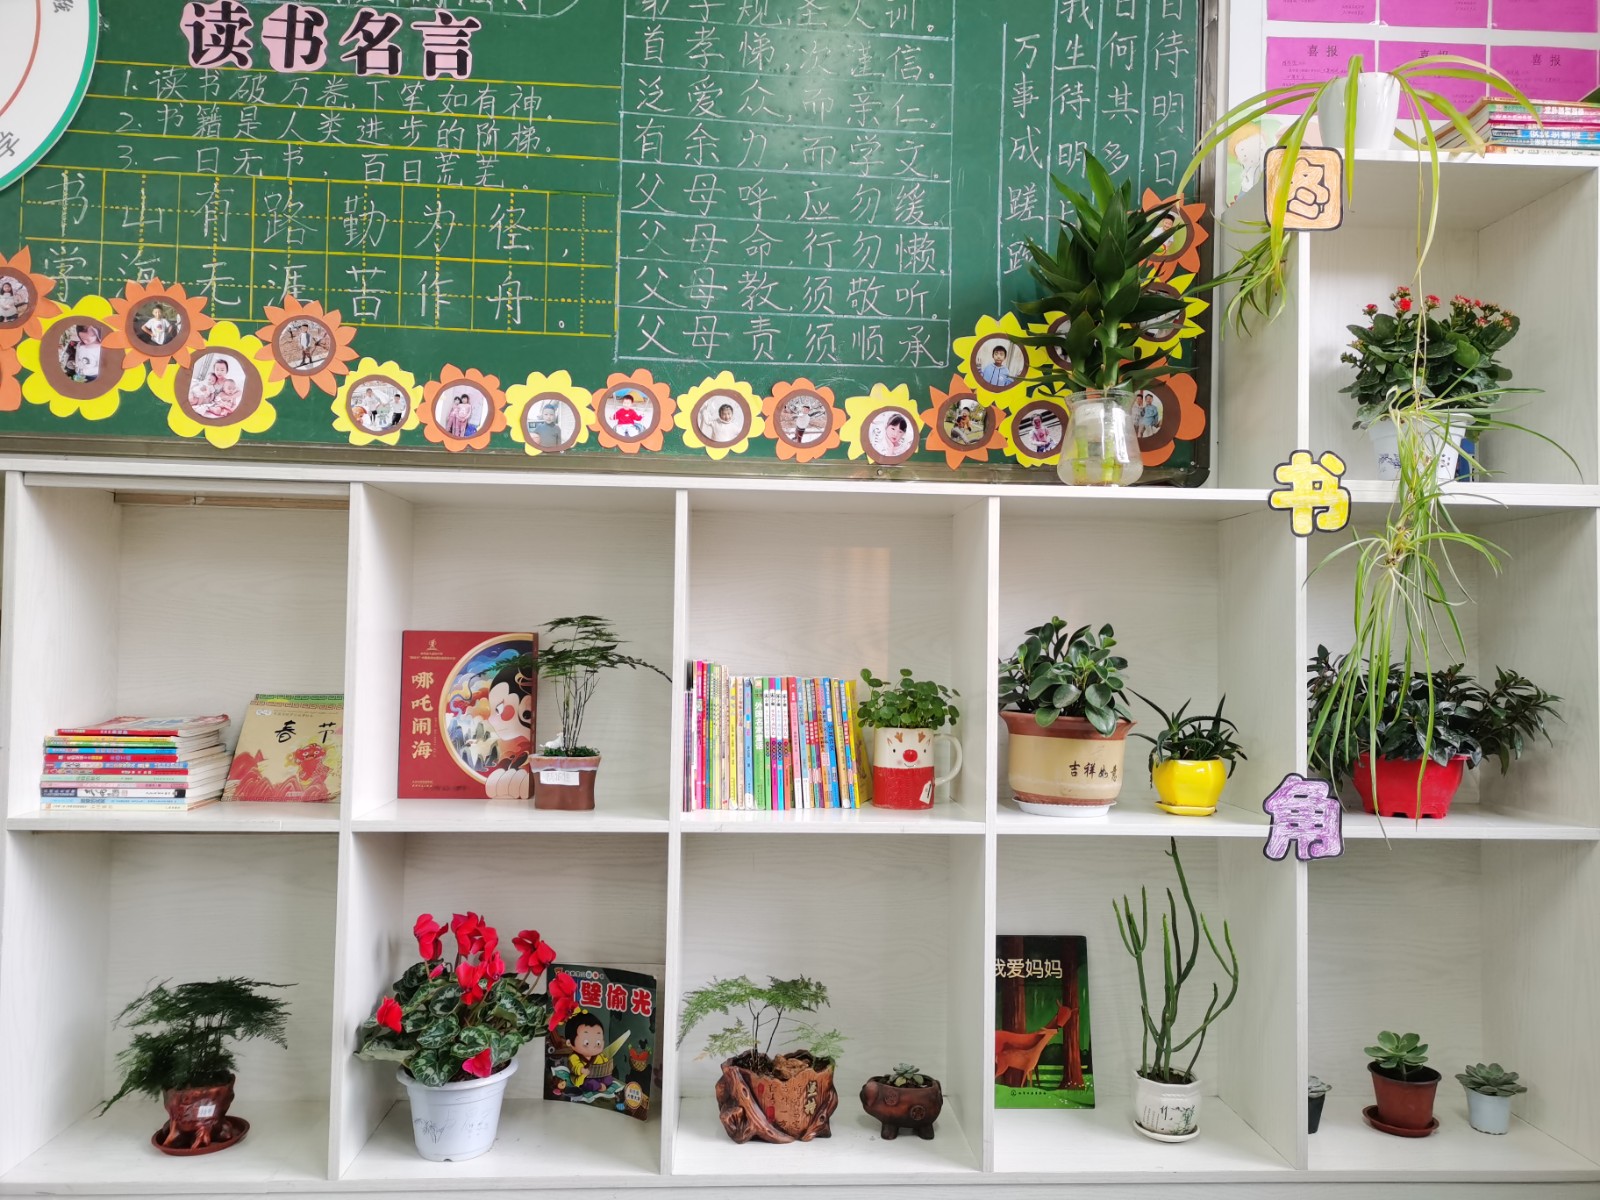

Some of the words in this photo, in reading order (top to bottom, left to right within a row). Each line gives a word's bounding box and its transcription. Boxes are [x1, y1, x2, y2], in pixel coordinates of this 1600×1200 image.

[186, 2, 481, 79] 读书名言
[1268, 449, 1351, 537] 书
[275, 720, 337, 744] 春节
[411, 671, 434, 760] 哪吒闹海
[1068, 760, 1118, 782] 吉祥如意
[1263, 772, 1344, 861] 角
[995, 958, 1063, 979] 我爱妈妈
